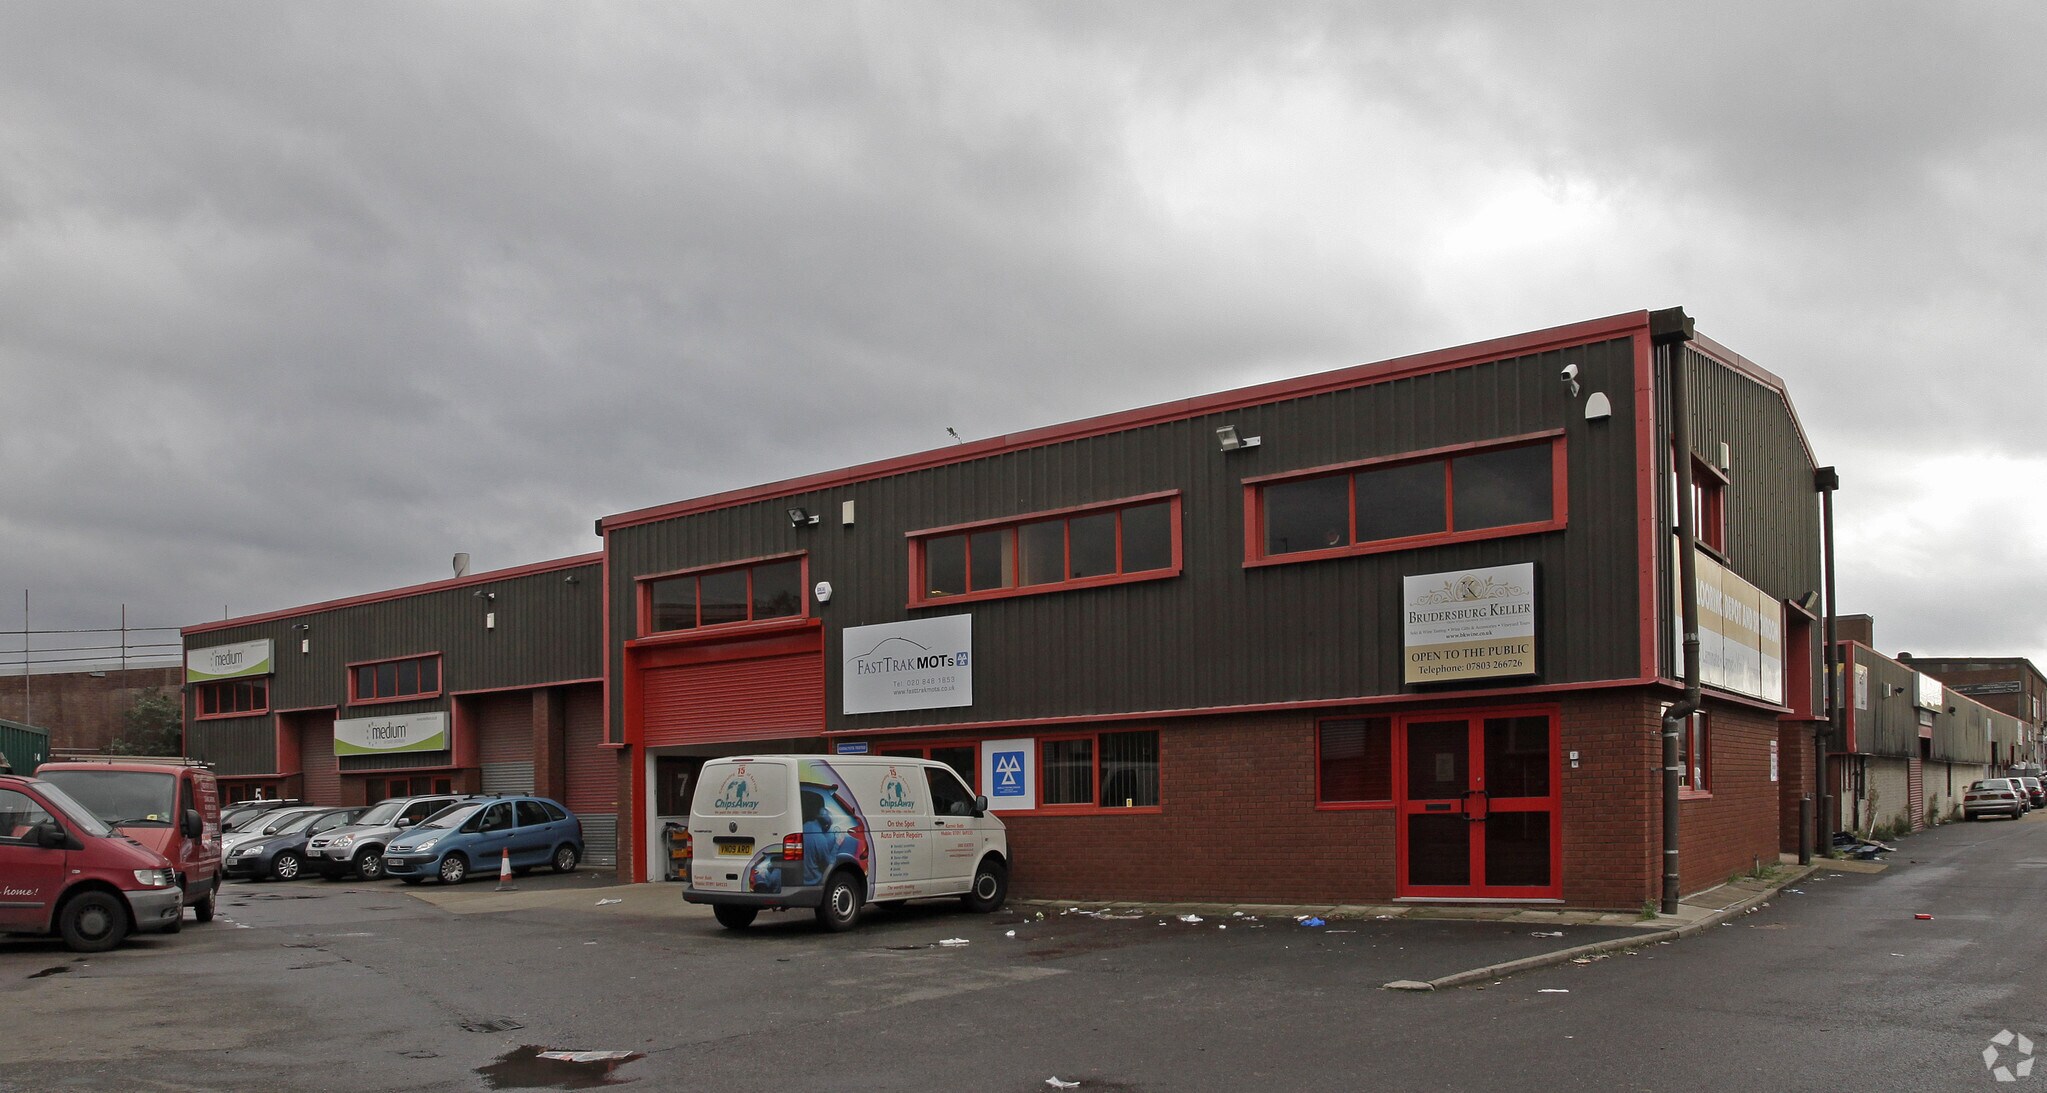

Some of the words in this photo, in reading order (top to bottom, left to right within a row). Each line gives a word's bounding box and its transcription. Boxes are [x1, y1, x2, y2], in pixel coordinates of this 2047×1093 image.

[1409, 608, 1487, 624] BRUDERSBURG
[1490, 603, 1531, 616] KELLER
[1446, 630, 1492, 639] www.bkwine.co.uk
[215, 650, 243, 666] medium
[1411, 651, 1441, 662] OPEN
[1444, 650, 1460, 660] TO
[1462, 648, 1485, 658] THE
[1488, 644, 1529, 656] PUBLIC
[1419, 664, 1464, 676] Telephone:
[1466, 661, 1491, 670] 07803
[1493, 659, 1523, 669] 266726
[372, 722, 406, 740] medium
[678, 773, 689, 797] 7
[715, 798, 760, 810] ChipsAway
[879, 798, 915, 809] ChipsAway
[887, 820, 894, 828] On
[895, 820, 903, 828] the
[904, 820, 915, 829] Spot
[906, 832, 923, 840] Repairs
[3, 886, 39, 896] home!
